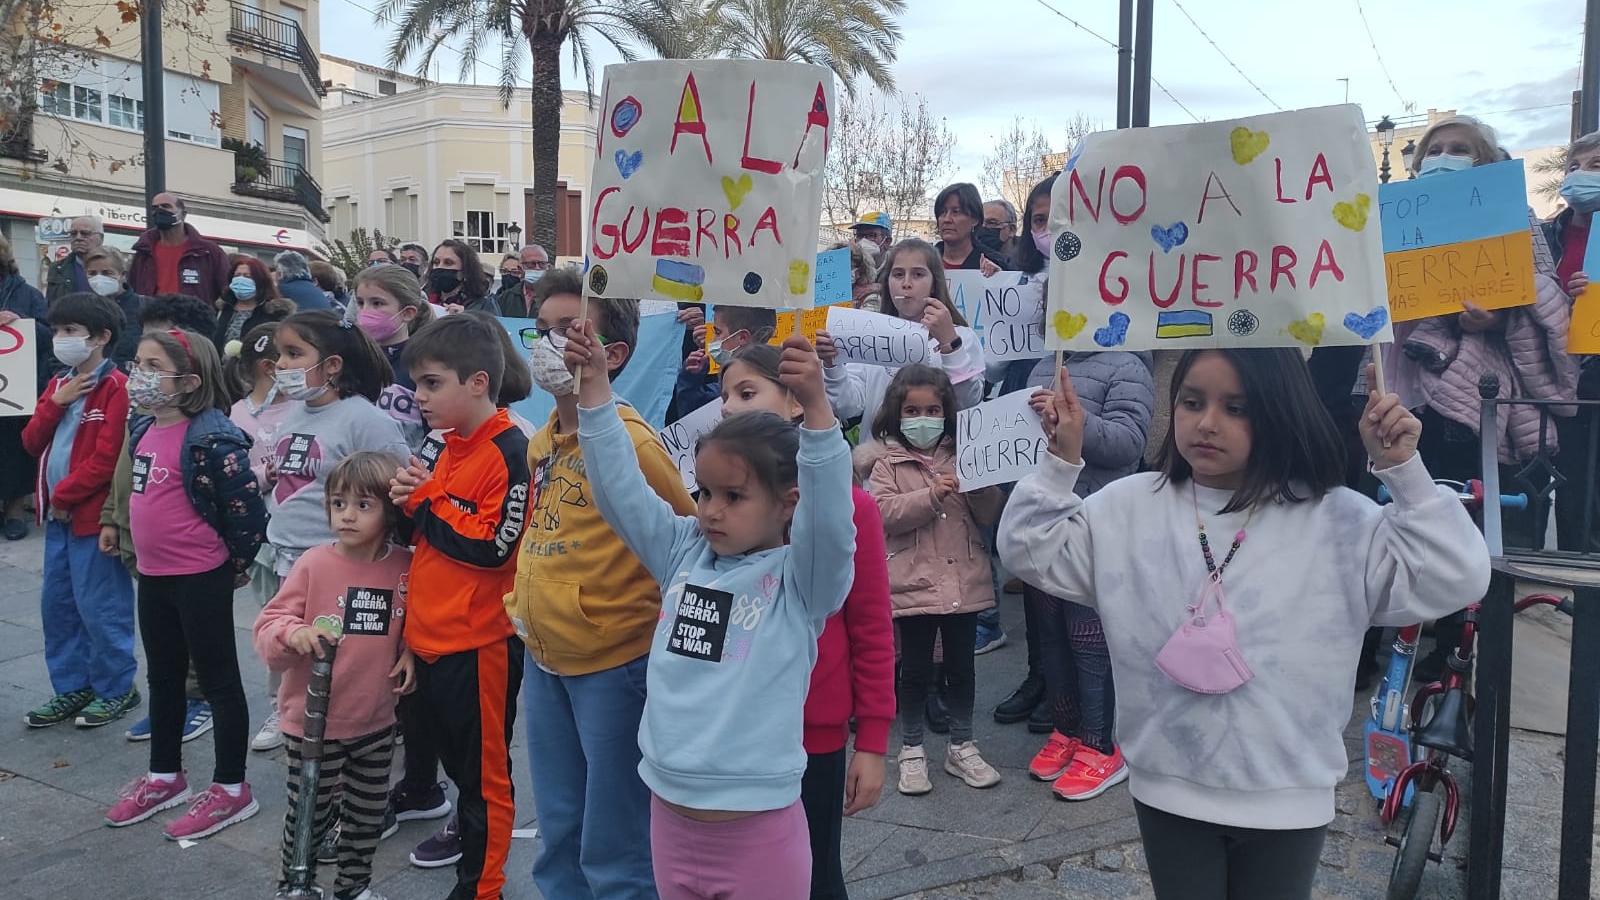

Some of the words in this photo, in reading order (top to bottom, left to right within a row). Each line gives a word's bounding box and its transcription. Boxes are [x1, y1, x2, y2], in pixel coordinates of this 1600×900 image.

[670, 70, 713, 168] A
[740, 79, 829, 175] LA
[1068, 164, 1147, 226] NO
[1198, 170, 1242, 224] A
[1274, 151, 1335, 204] LA
[1470, 186, 1483, 207] A
[592, 186, 784, 260] GUERRA
[1402, 226, 1425, 247] LA
[1098, 238, 1345, 309] GUERRA
[985, 287, 1021, 317] NO
[959, 407, 983, 446] NO
[990, 417, 1001, 435] A
[1004, 411, 1030, 429] LA
[660, 422, 691, 456] NO
[959, 437, 1048, 481] GUERRA
[351, 599, 387, 610] GUERRA
[357, 590, 371, 601] NO
[683, 591, 698, 606] NO
[705, 600, 717, 610] LA
[355, 612, 380, 622] STOP
[679, 602, 720, 624] GUERRA
[350, 622, 363, 630] THE
[363, 621, 384, 631] WAR
[677, 622, 706, 640] STOP
[671, 637, 682, 649] THE
[682, 637, 713, 656] WAR
